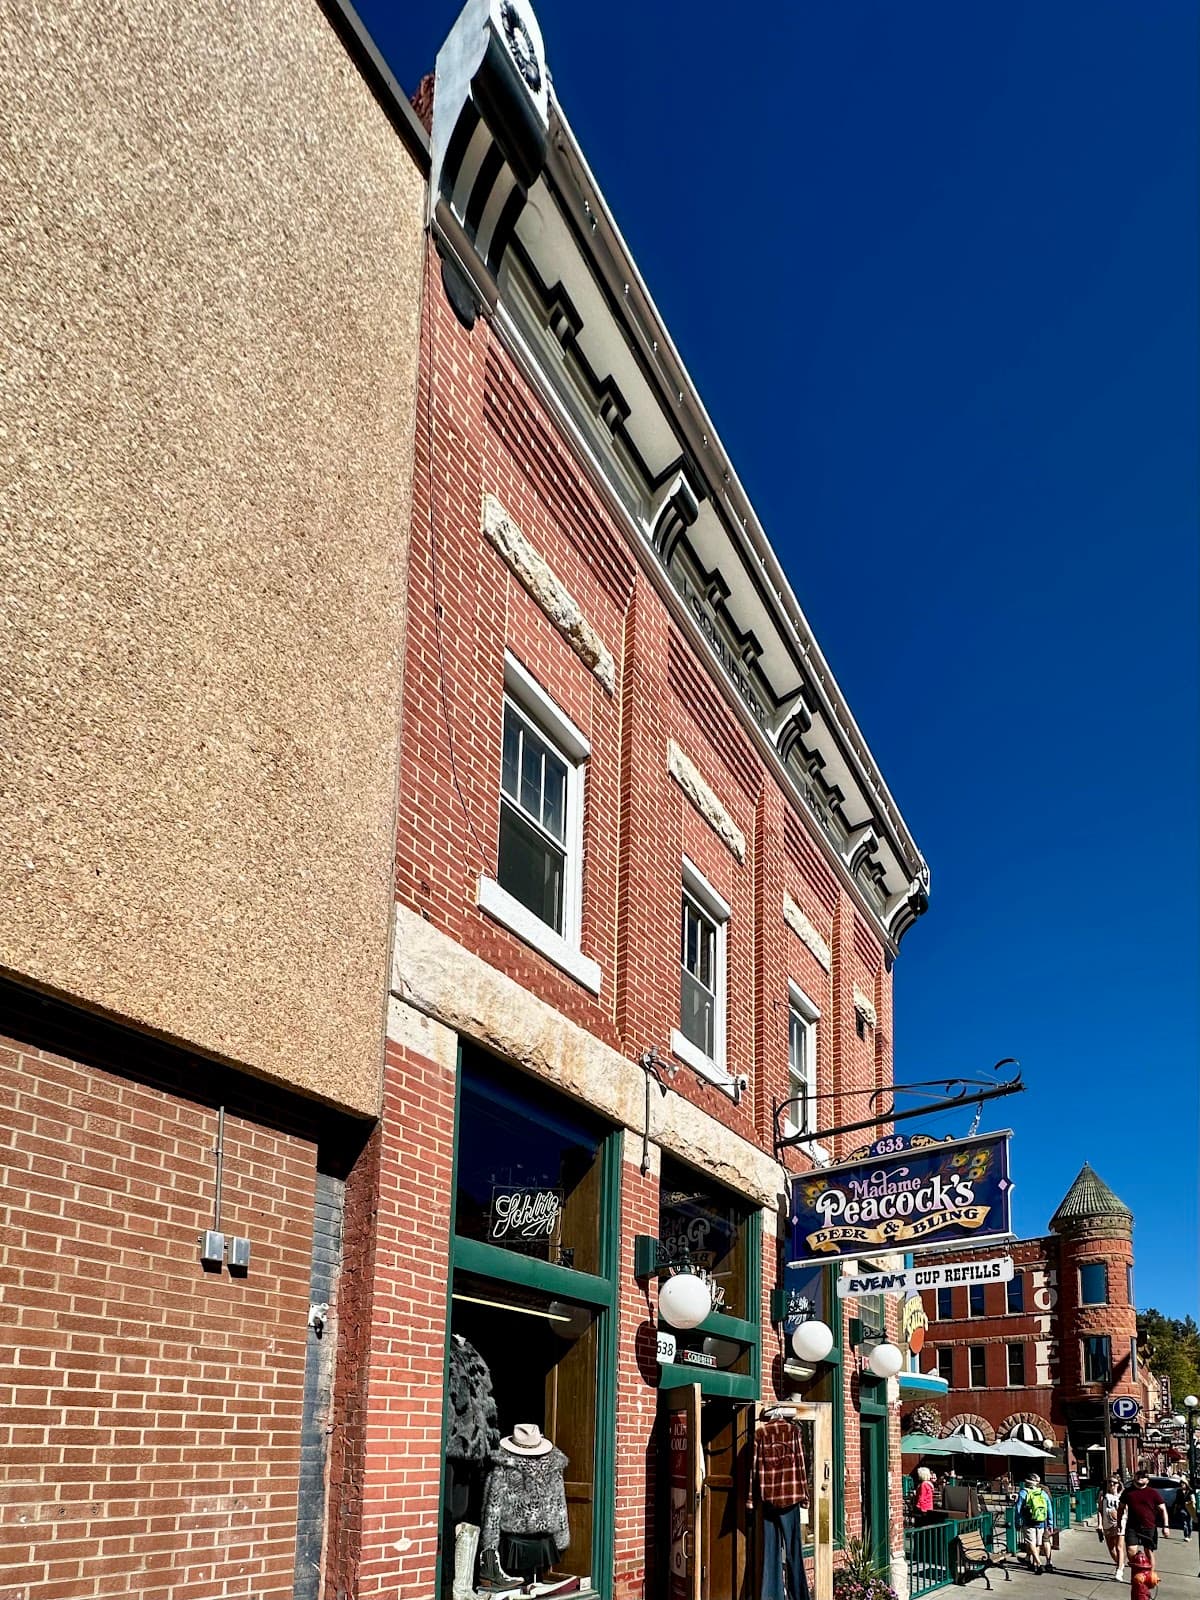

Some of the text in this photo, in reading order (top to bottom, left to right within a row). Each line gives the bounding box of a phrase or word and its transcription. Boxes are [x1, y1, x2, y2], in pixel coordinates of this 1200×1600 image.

[876, 1136, 904, 1155] 638
[849, 1167, 922, 1201] Madame
[815, 1174, 975, 1228] Peacock's
[815, 1208, 980, 1245] BEER & BLING
[849, 1263, 1001, 1292] EVENT CUP REFILLS
[1032, 1270, 1061, 1386] HOTEL
[656, 1340, 674, 1356] 638
[1118, 1400, 1134, 1417] P
[670, 1438, 688, 1451] COLD
